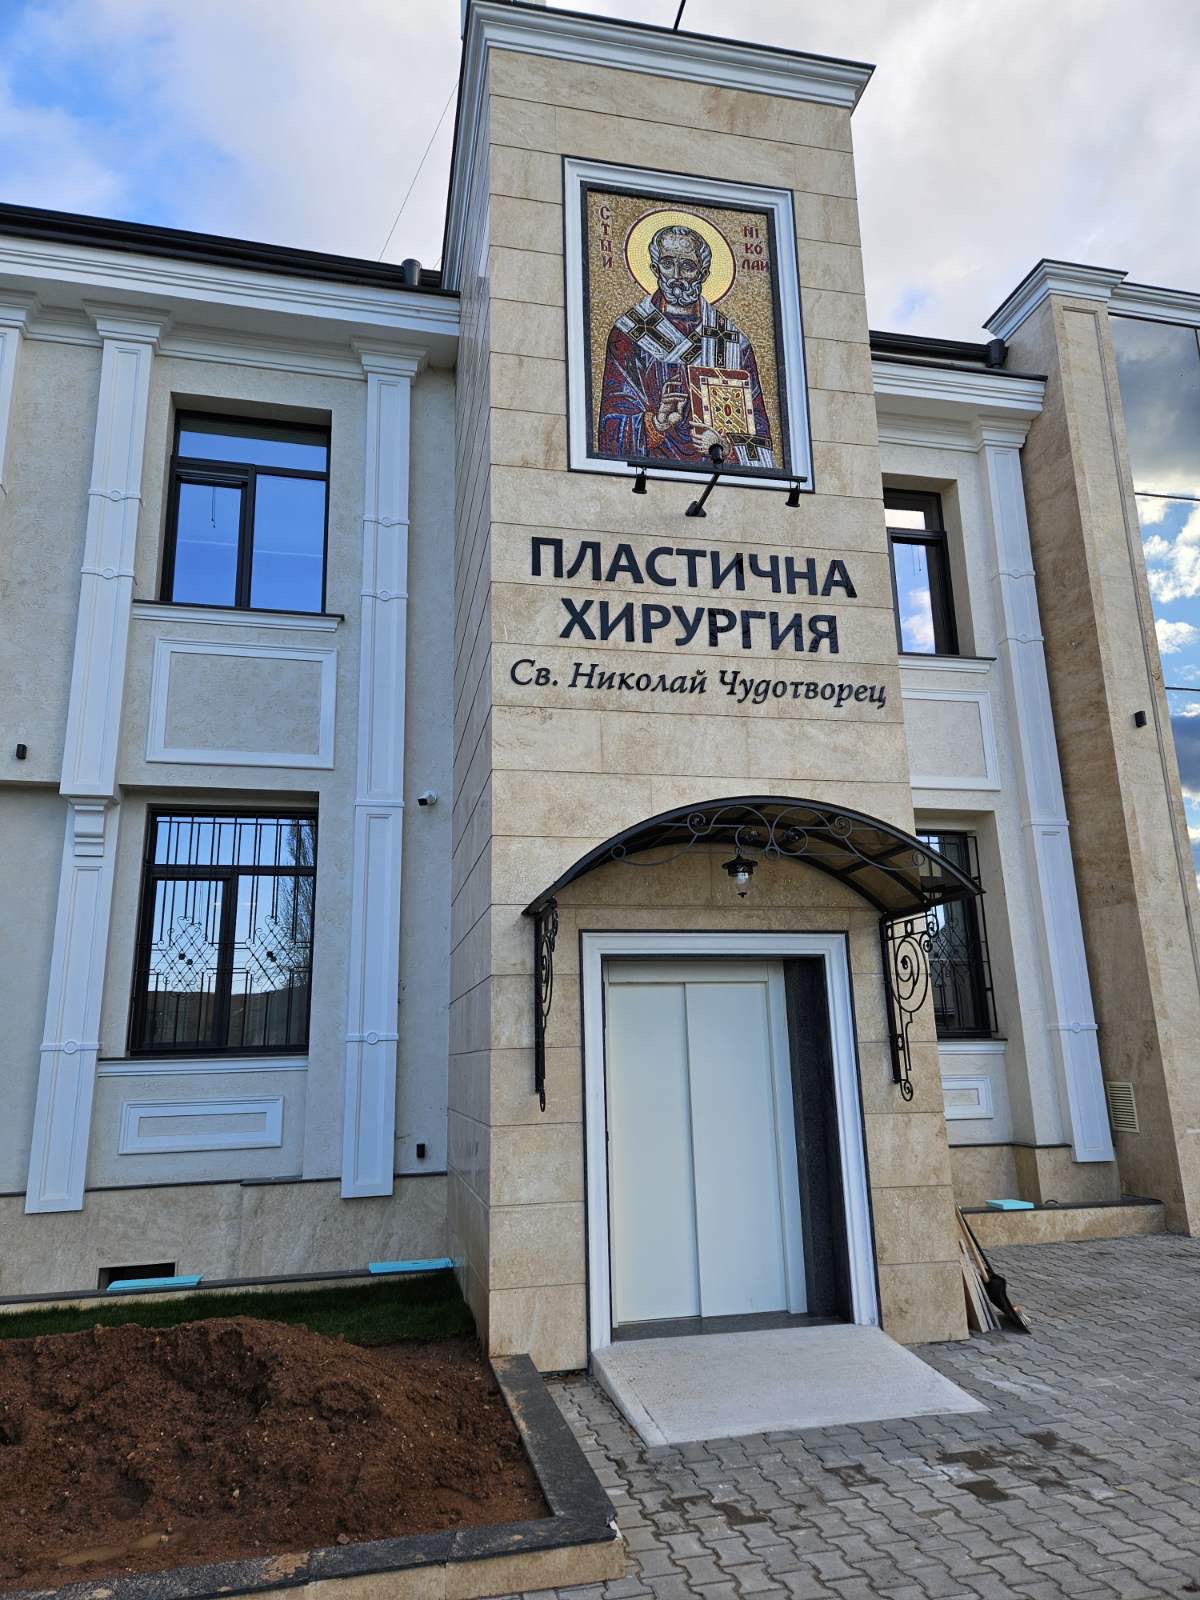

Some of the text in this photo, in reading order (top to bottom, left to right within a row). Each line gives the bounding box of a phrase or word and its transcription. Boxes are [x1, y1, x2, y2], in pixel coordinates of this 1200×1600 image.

[531, 536, 858, 598] ПЛАСТИЧНА
[559, 597, 840, 654] ХИРУРГИЯ
[510, 659, 887, 709] Св. Николай Чудотворец
